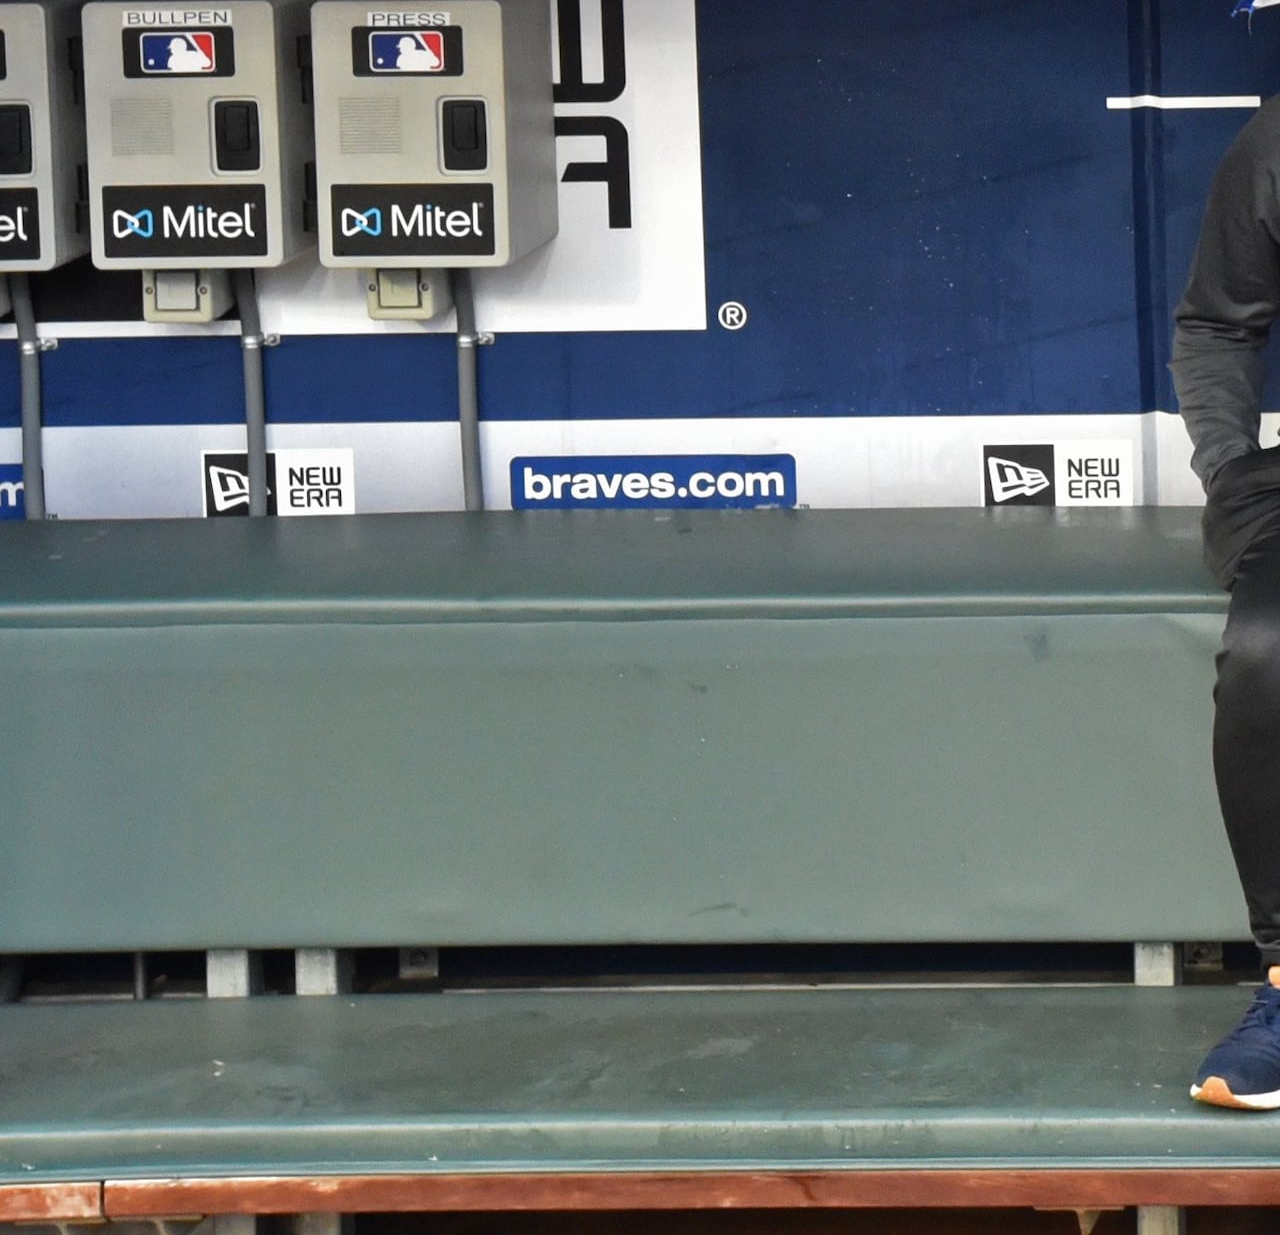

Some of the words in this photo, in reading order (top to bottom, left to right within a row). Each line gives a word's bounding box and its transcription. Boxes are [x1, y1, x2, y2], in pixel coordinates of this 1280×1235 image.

[127, 10, 228, 25] BULLPEN
[372, 13, 446, 26] PRESS
[162, 202, 255, 239] Mitel
[391, 202, 484, 238] Mitel
[288, 466, 342, 486] NEW
[1068, 458, 1121, 477] NEW
[523, 466, 785, 500] braves.com
[1068, 480, 1121, 499] ERA
[289, 488, 343, 508] ERA
